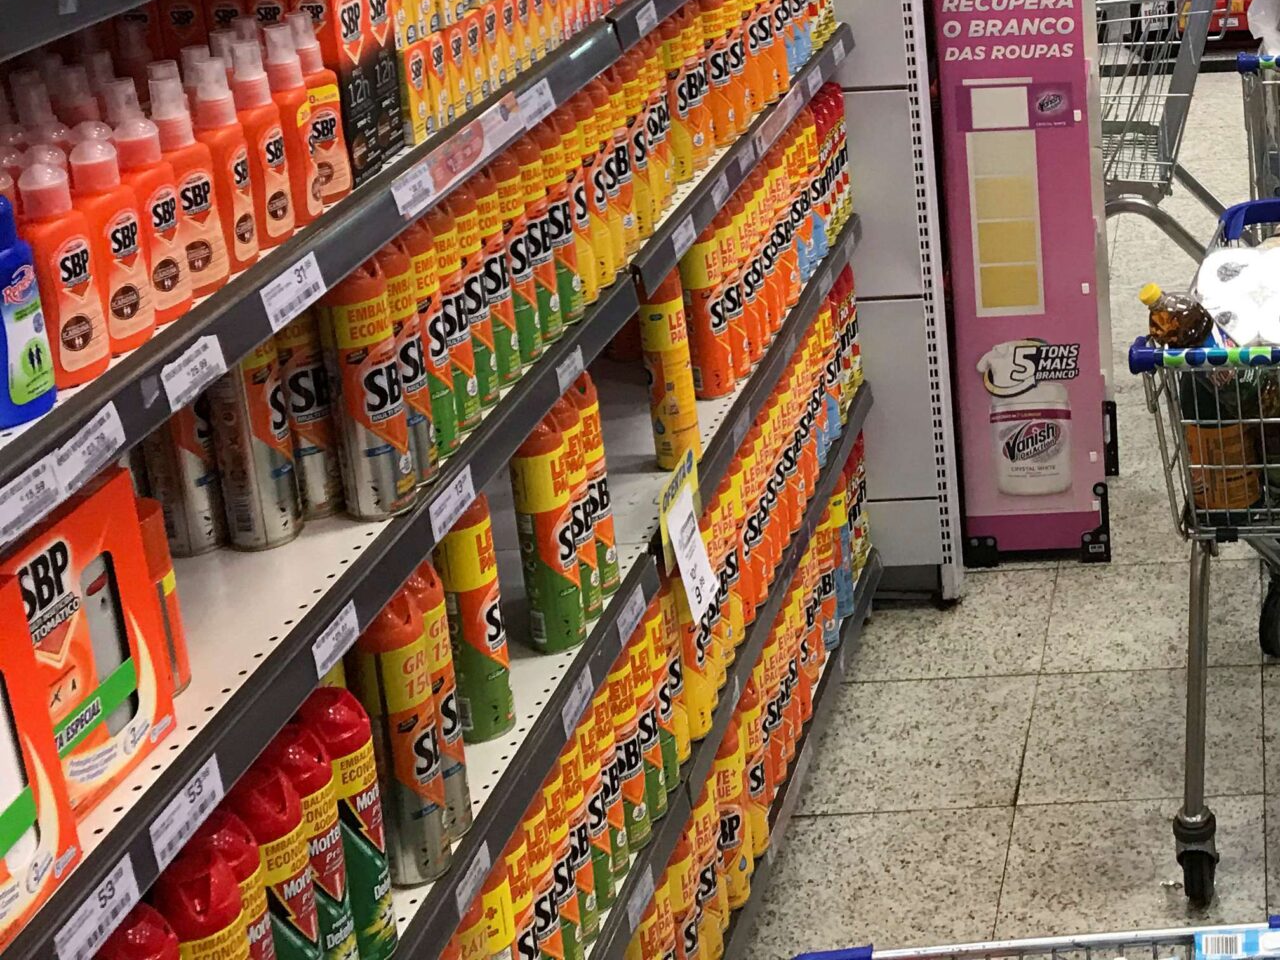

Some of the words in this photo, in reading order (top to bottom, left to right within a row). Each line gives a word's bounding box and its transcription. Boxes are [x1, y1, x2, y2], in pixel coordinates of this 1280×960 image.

[256, 6, 280, 23] SBP
[341, 2, 360, 38] SBP
[943, 21, 961, 38] O
[968, 17, 1075, 38] BRANCO
[945, 45, 986, 61] DAS
[991, 43, 1074, 60] ROUPAS
[349, 79, 370, 108] 12h
[312, 117, 336, 139] SBP
[180, 181, 210, 210] SBP
[152, 197, 176, 227] SBP
[111, 221, 138, 253] SBP
[60, 248, 89, 282] SBP
[1010, 347, 1036, 381] 5
[1039, 357, 1077, 371] MAIS
[1040, 345, 1079, 358] TONS
[1004, 422, 1056, 461] Vanish
[18, 540, 69, 622] SBP
[65, 698, 102, 742] ESPECIAL
